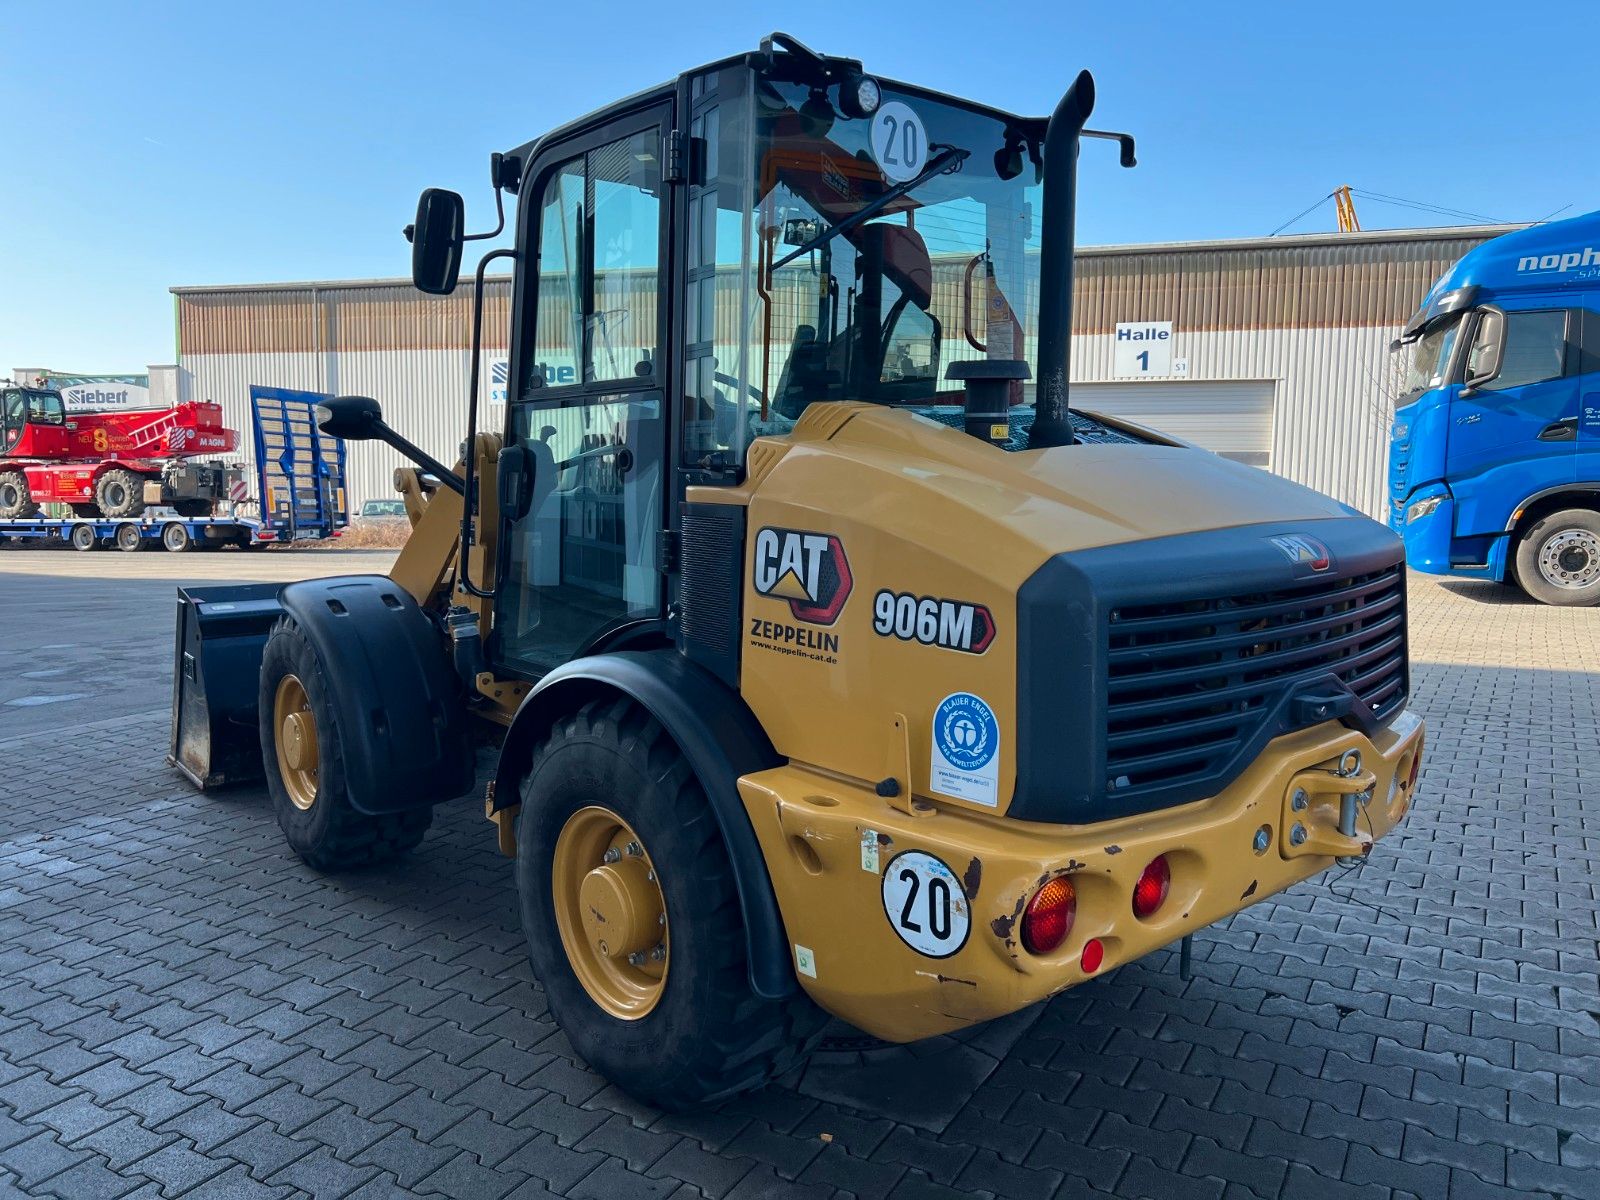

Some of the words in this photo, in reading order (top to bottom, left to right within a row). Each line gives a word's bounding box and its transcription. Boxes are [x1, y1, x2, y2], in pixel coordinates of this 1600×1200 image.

[883, 115, 917, 168] 20
[1117, 328, 1169, 341] Halle
[1136, 350, 1149, 371] 1
[68, 389, 128, 404] Siebert
[93, 428, 109, 452] 8
[199, 437, 226, 447] MAGNI
[755, 529, 829, 602] CAT
[875, 592, 975, 649] 906M
[751, 618, 839, 653] ZEPPELIN
[750, 640, 838, 664] www.zeppelin-cat.de
[943, 697, 969, 713] BLAUER
[971, 699, 991, 722] ENGEL
[899, 868, 952, 941] 20
